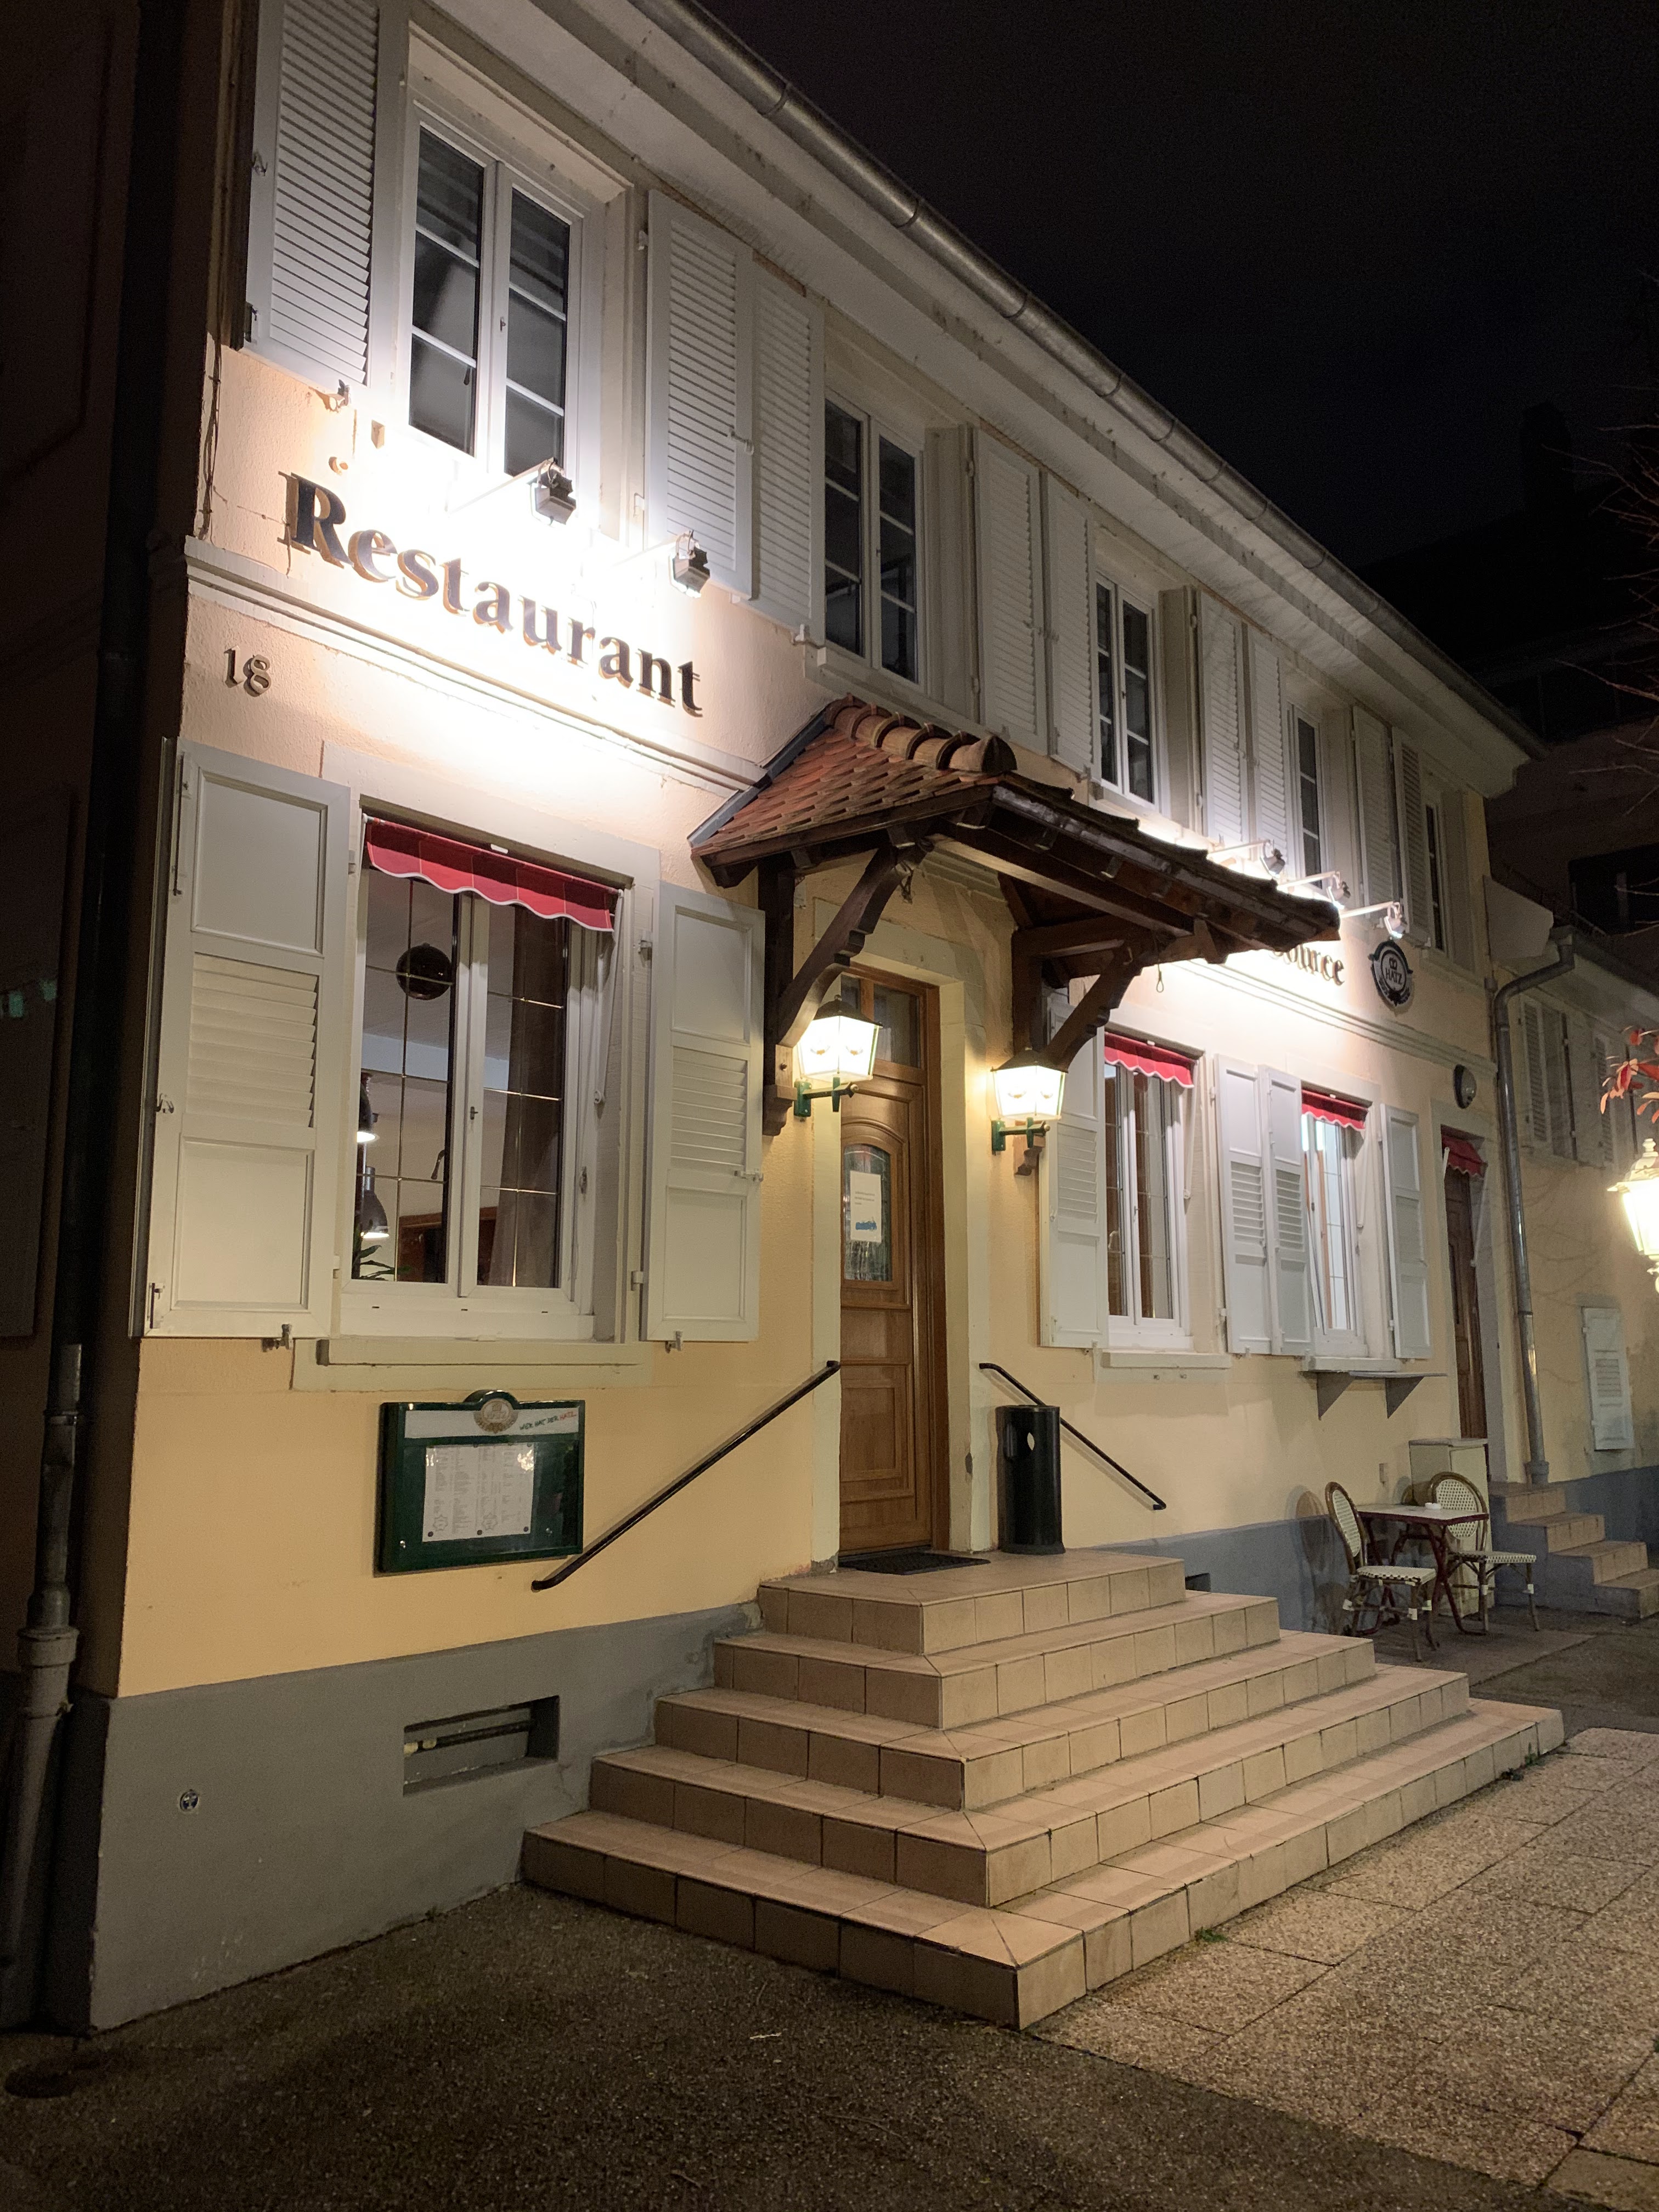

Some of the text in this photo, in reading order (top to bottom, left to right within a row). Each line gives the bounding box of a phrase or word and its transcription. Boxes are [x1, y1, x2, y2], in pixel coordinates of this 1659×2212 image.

[284, 472, 703, 714] Restaurant
[223, 646, 272, 697] 18
[1385, 967, 1403, 985] HATZ
[560, 1411, 577, 1420] HATZ
